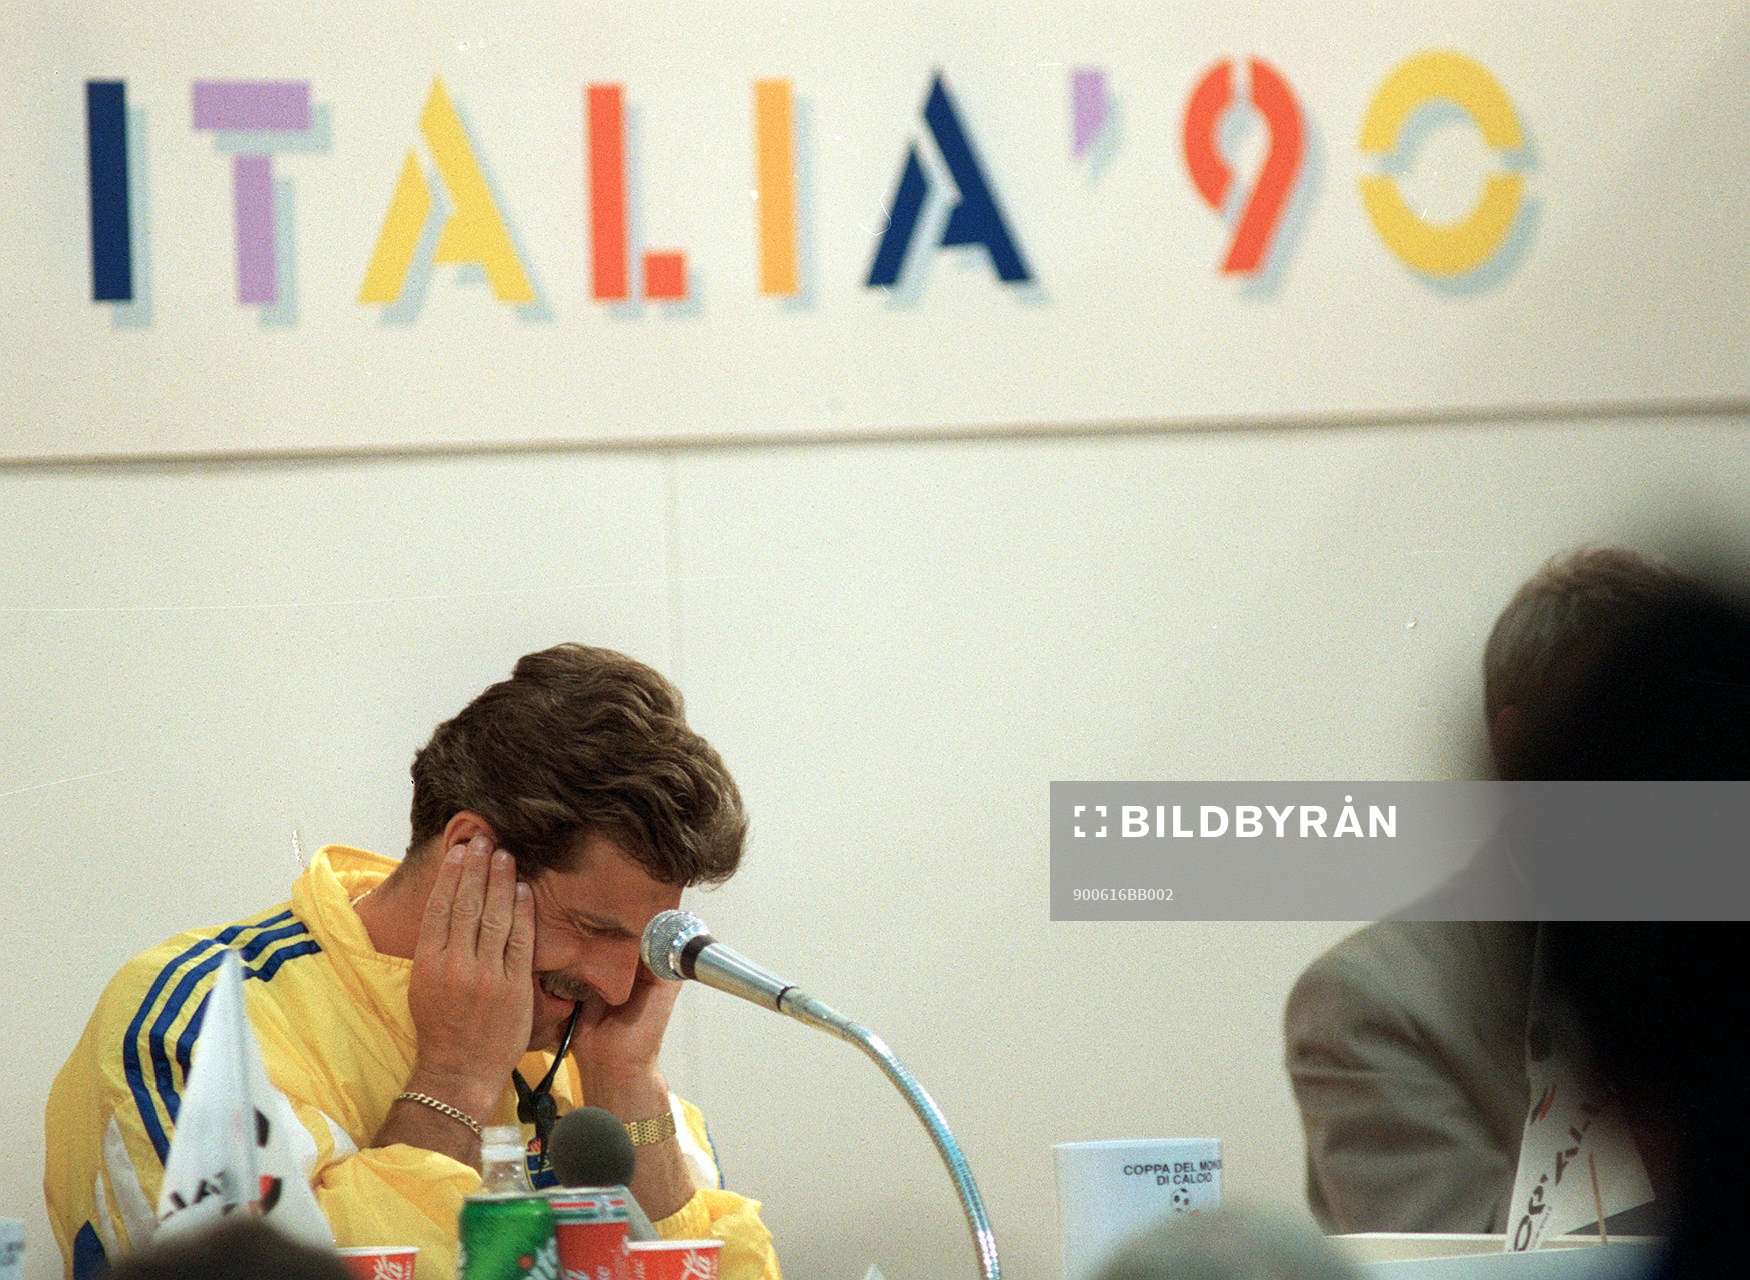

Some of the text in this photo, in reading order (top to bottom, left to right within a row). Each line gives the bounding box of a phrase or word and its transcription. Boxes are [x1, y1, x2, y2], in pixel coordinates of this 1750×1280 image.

[1123, 1163, 1170, 1176] COPPA
[1174, 1162, 1197, 1173] DEL
[1157, 1172, 1212, 1186] DI CALCIO
